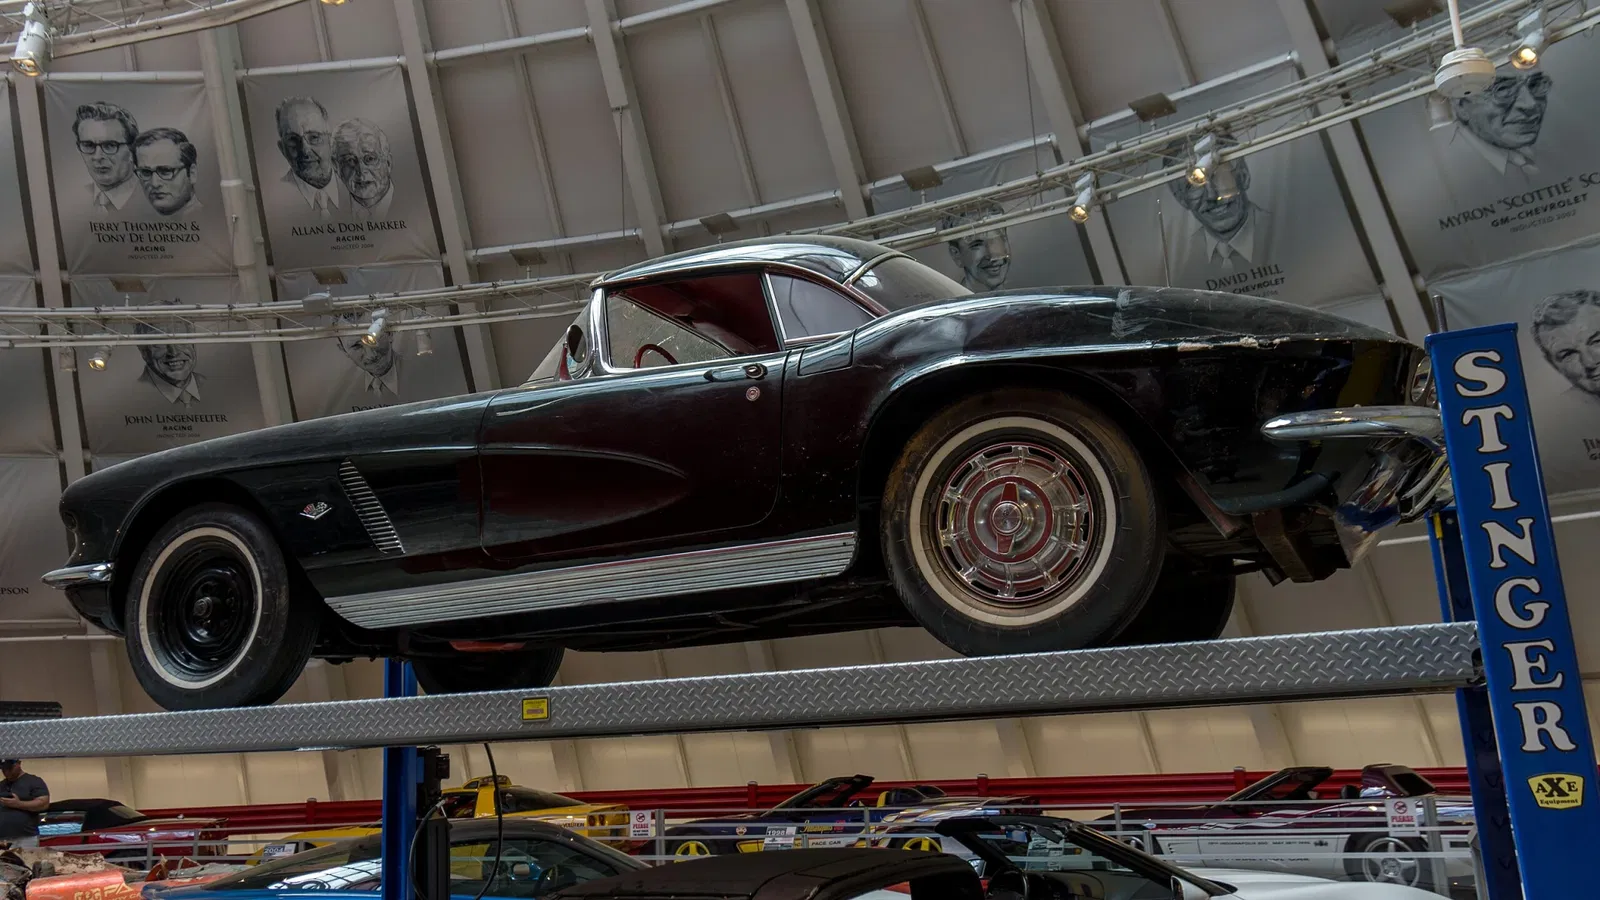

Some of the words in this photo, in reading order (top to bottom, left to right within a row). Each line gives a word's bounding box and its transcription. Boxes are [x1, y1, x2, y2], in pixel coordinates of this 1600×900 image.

[1438, 203, 1496, 231] MYRON
[1491, 193, 1588, 228] GM-CHEVROLET
[89, 221, 119, 233] JERRY
[121, 221, 188, 232] THOMPSON
[190, 221, 200, 231] &
[291, 226, 324, 236] ALLAN
[327, 223, 336, 234] &
[338, 222, 364, 233] DON
[367, 220, 408, 230] BARKER
[95, 233, 125, 243] TONY
[129, 233, 144, 243] DE
[148, 232, 200, 243] LORENZO
[1206, 273, 1248, 291] DAVID
[1250, 263, 1284, 279] HILL
[1232, 277, 1286, 294] CHEVROLET
[124, 415, 153, 426] JOHN
[156, 414, 228, 423] LINGENFELTER
[1453, 349, 1579, 753] STINGER
[0, 587, 29, 595] PSON
[1535, 777, 1579, 797] AXE
